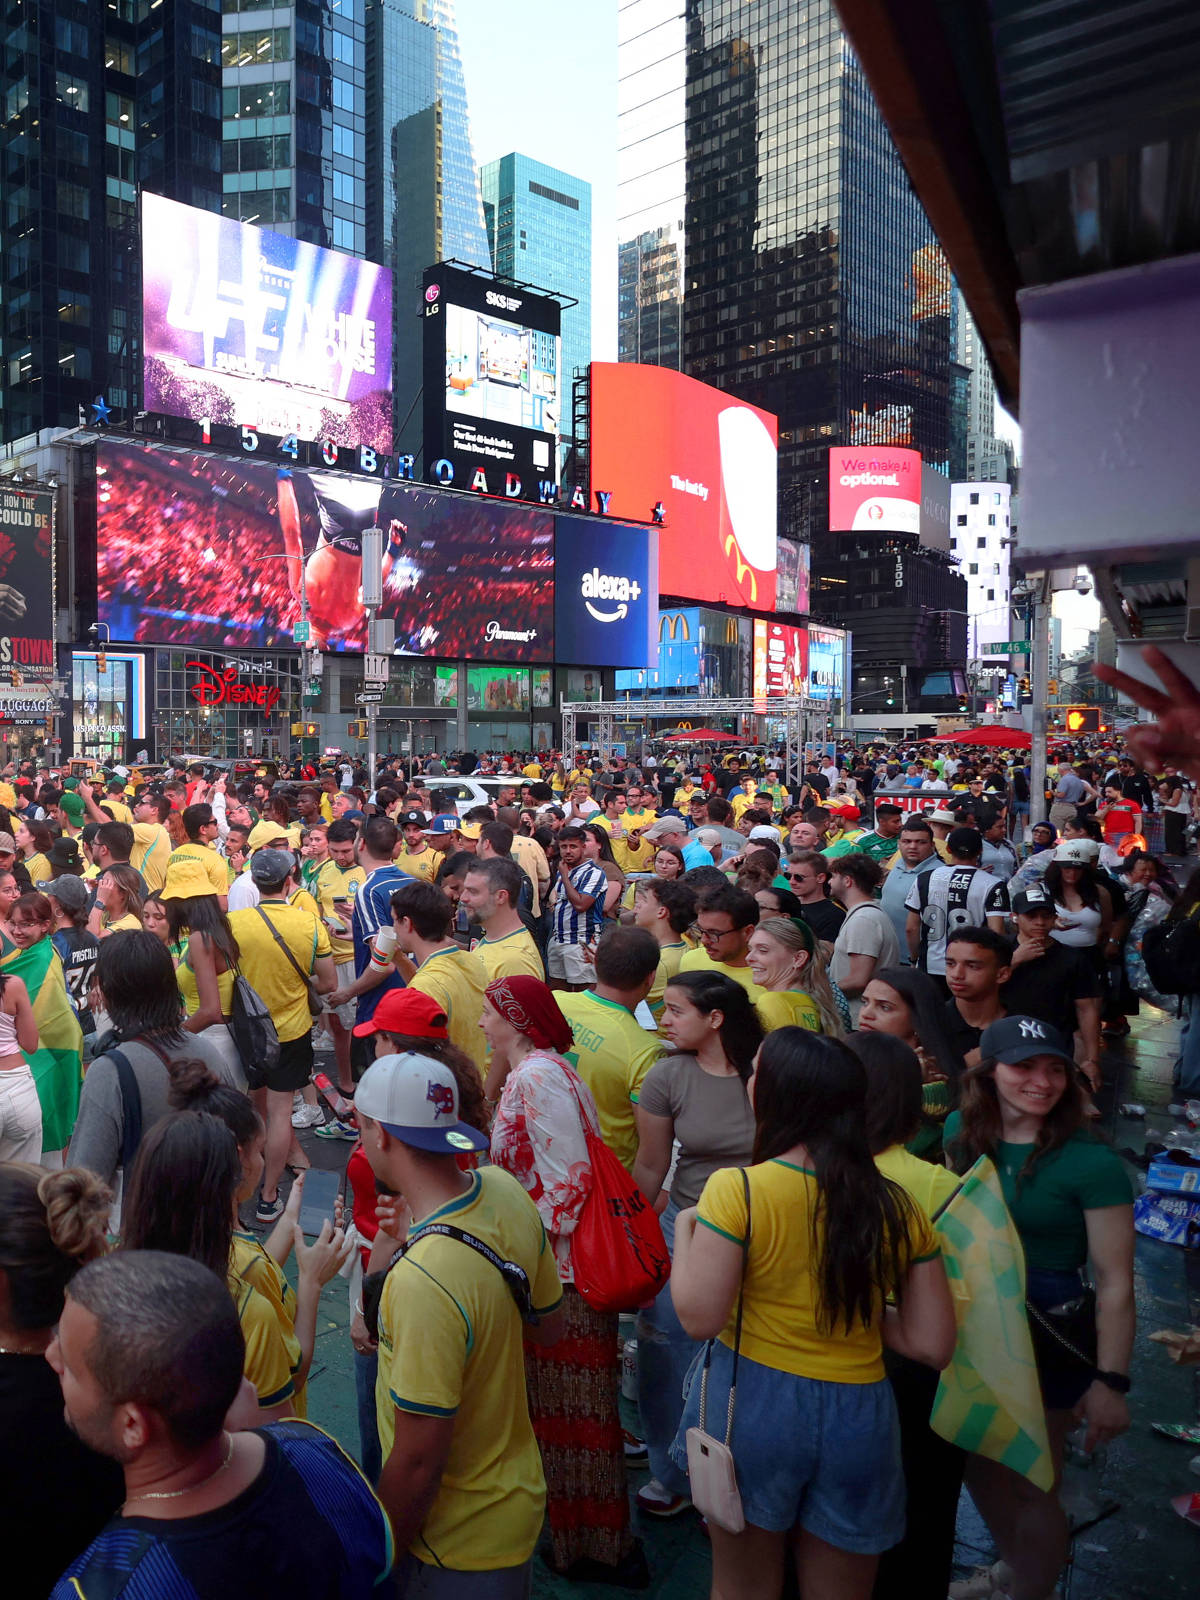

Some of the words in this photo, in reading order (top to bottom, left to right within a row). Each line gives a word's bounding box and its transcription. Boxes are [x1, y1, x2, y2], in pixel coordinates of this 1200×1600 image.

[486, 290, 507, 309] SKS
[426, 303, 439, 317] LG
[841, 459, 867, 471] We
[868, 458, 900, 472] make
[357, 444, 614, 514] BROADWAY
[670, 474, 686, 492] The
[839, 471, 900, 488] optional.
[4, 494, 20, 508] HOW
[20, 497, 35, 510] THE
[34, 513, 48, 528] BE
[895, 555, 903, 588] 1500
[581, 567, 641, 601] alexa+
[992, 644, 1001, 653] W
[1007, 643, 1020, 652] 46
[978, 666, 1007, 679] asdaq
[0, 699, 53, 712] LUGGAGE
[88, 725, 106, 733] POLO
[106, 725, 127, 733] ASSN.
[1018, 1019, 1047, 1039] NY
